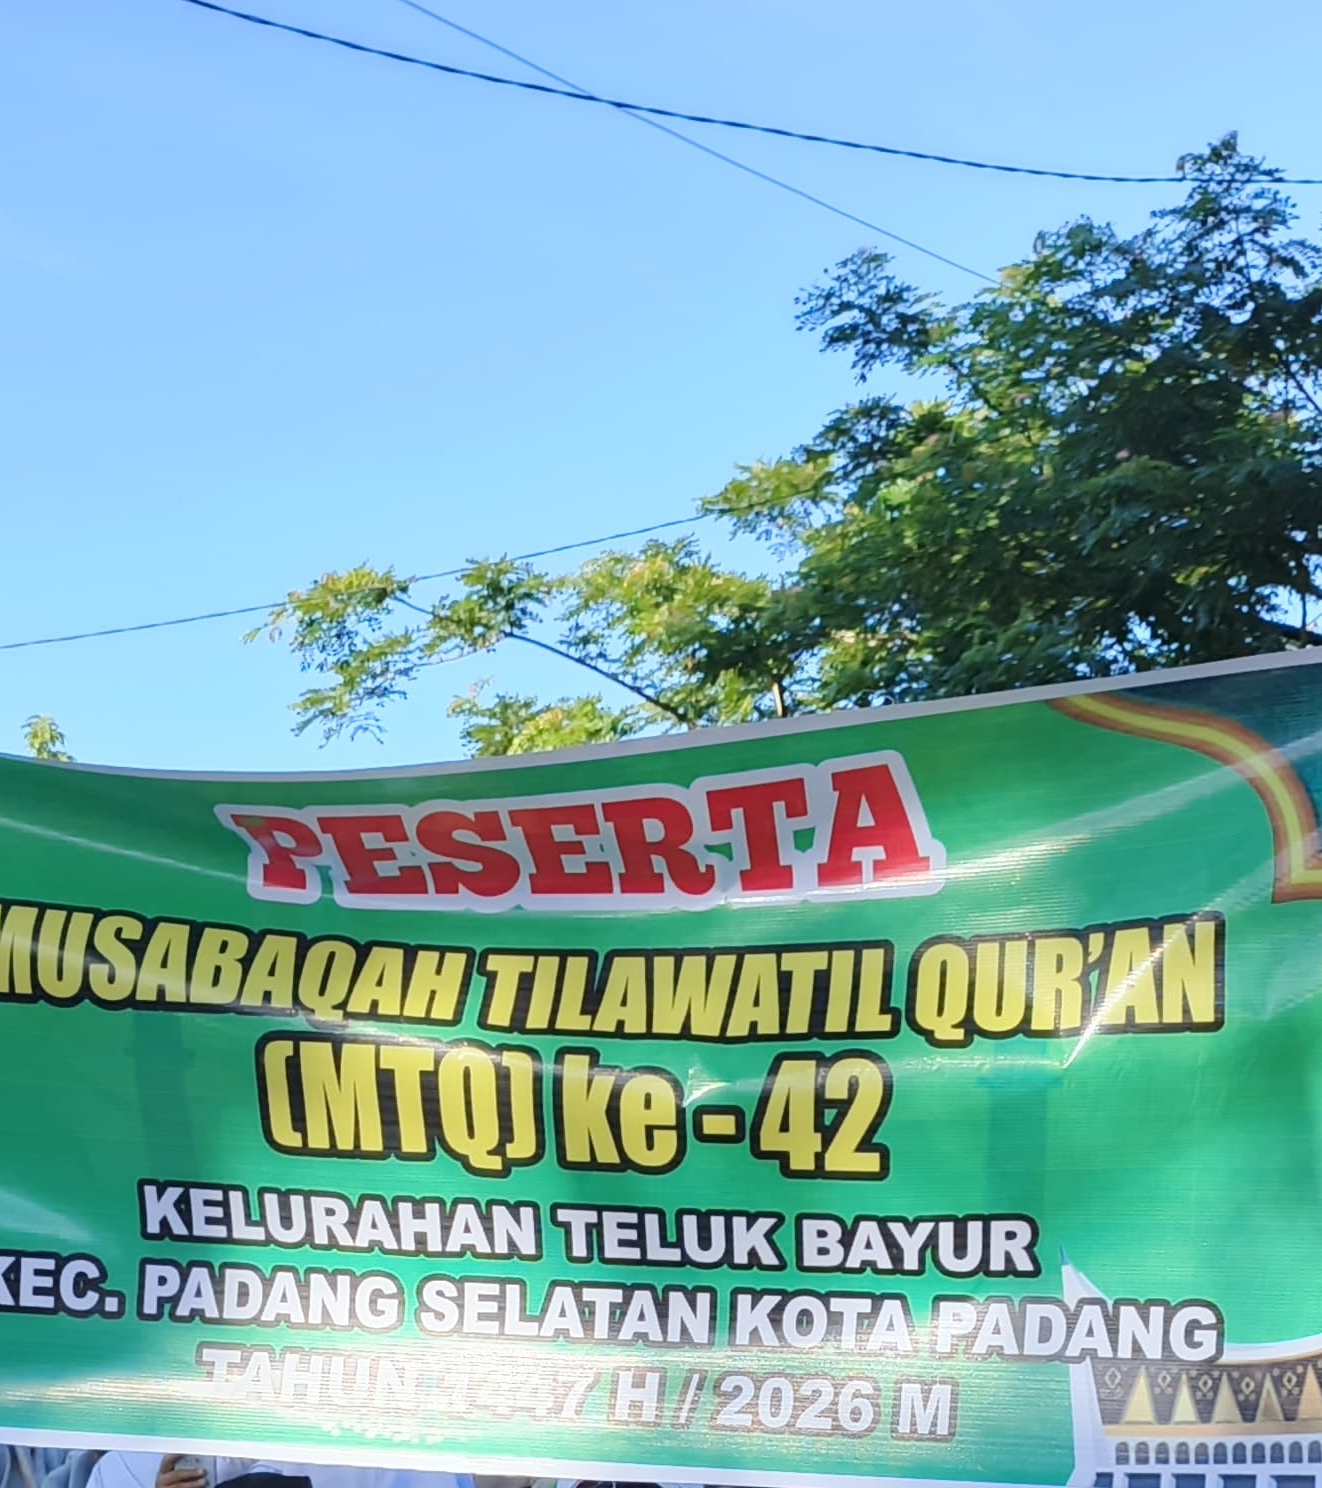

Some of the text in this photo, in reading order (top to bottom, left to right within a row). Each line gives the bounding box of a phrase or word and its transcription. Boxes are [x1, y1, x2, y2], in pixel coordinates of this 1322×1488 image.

[230, 761, 931, 896] PESERTA
[482, 946, 892, 1037] TILAWATIL
[913, 920, 1218, 1042] QUR'AN
[262, 1040, 886, 1174] (MTQ) ke - 42
[144, 1185, 1035, 1272] KELURAHAN TELUK BAYUR
[144, 1264, 397, 1331] PADANG
[418, 1280, 710, 1346] SELATAN
[736, 1294, 915, 1353] KOTA
[936, 1302, 1219, 1362] PADANG
[201, 1347, 419, 1409] TAHUN
[617, 1369, 661, 1423] H
[678, 1371, 698, 1426] /
[717, 1377, 875, 1433] 2026
[899, 1381, 953, 1436] M
